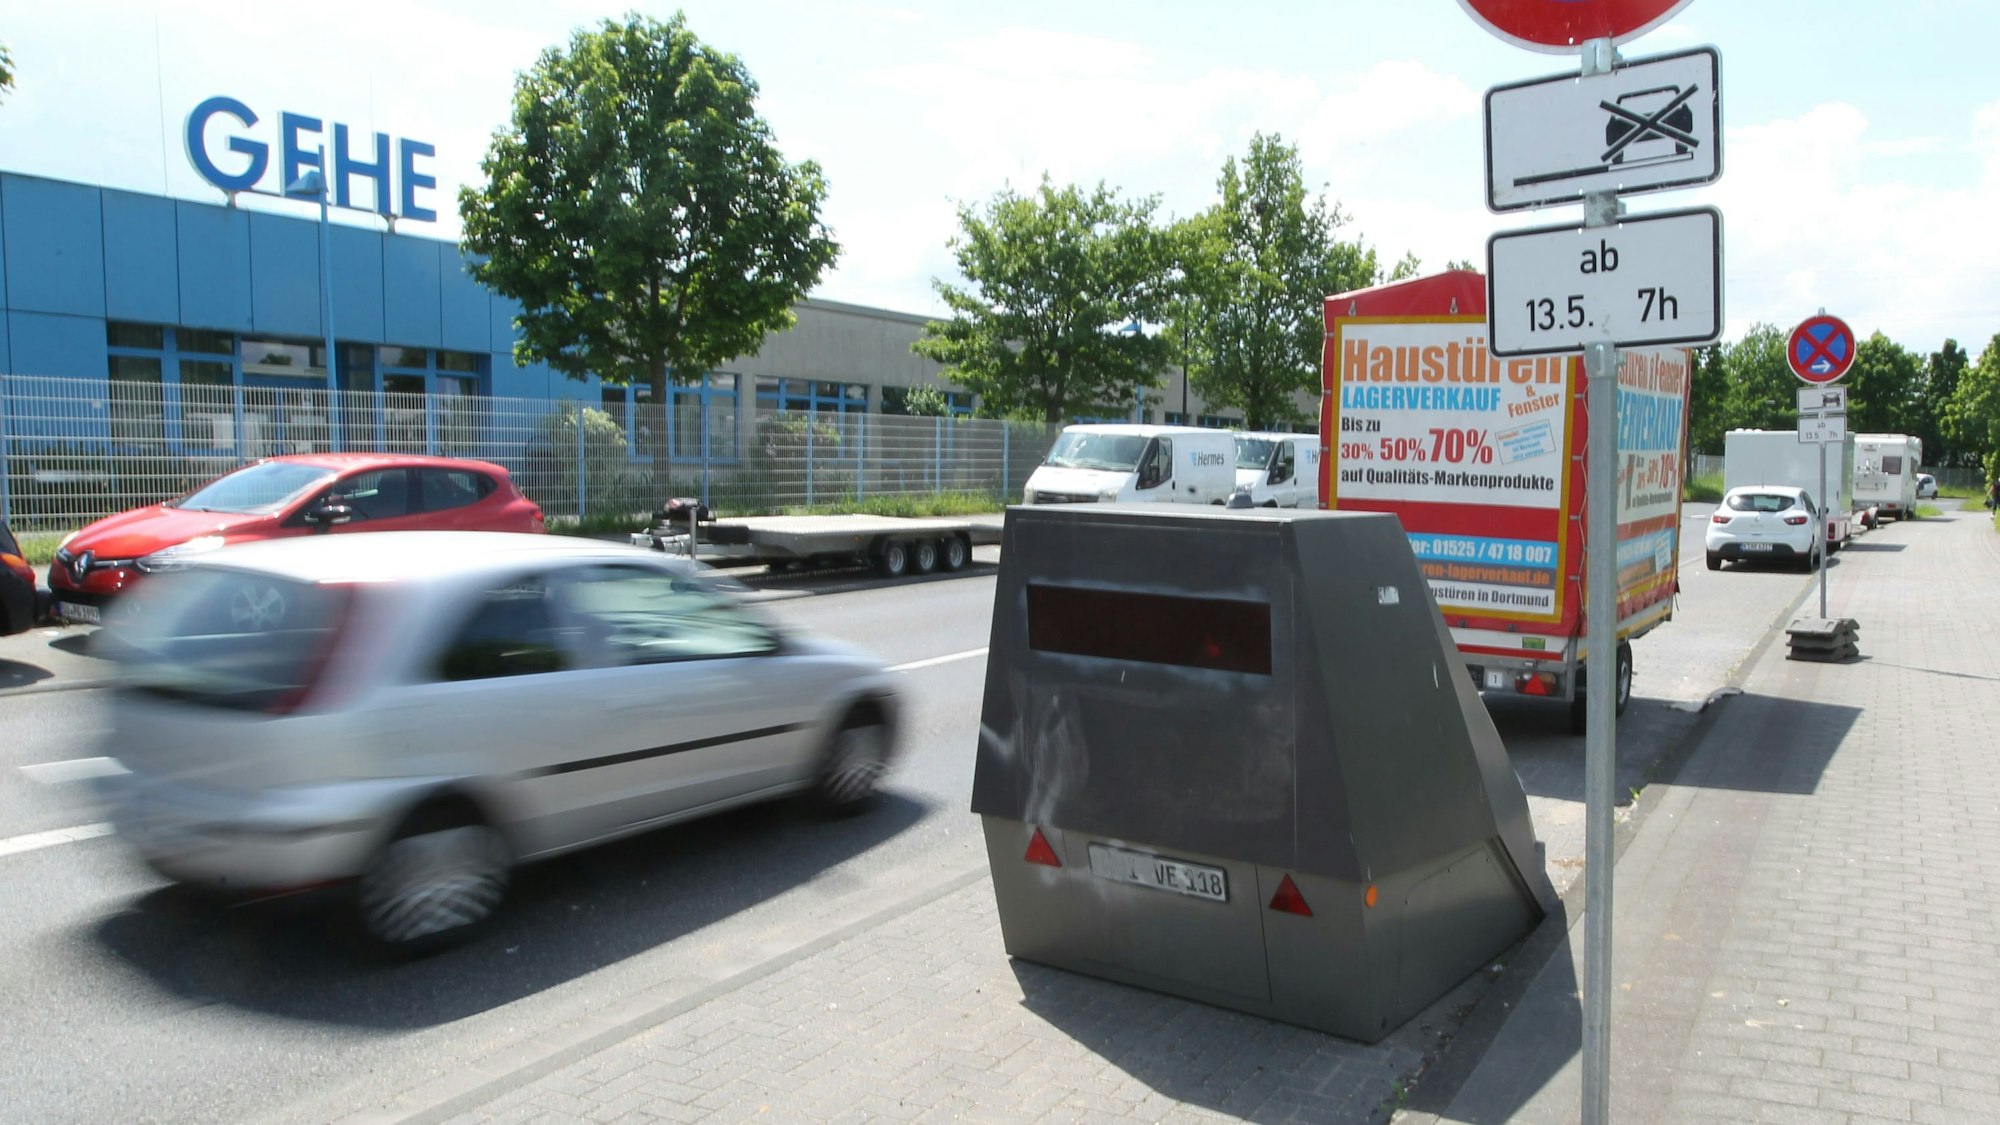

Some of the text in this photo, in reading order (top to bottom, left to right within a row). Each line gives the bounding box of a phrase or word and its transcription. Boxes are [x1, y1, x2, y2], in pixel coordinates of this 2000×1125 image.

[183, 95, 437, 222] GEHE
[1580, 239, 1619, 274] ab
[1526, 287, 1678, 332] 13.5. 7h
[1342, 386, 1501, 412] LAGERVERKAUF
[1525, 384, 1536, 398] &
[1507, 393, 1560, 418] Fenster
[1341, 417, 1381, 432] Bis zu
[1817, 421, 1826, 429] ab
[1828, 430, 1838, 439] 7h
[1341, 443, 1374, 460] 30%
[1380, 438, 1426, 462] 50%
[1429, 428, 1493, 464] 70%
[1198, 451, 1225, 467] Hermes
[1341, 468, 1554, 491] auf Qualitäts-Markenprodukte
[1433, 538, 1475, 557] 01525
[1478, 541, 1486, 560] /
[1488, 543, 1504, 559] 47
[1507, 543, 1522, 562] 18
[1525, 546, 1552, 563] 007
[1478, 589, 1489, 603] in
[1491, 590, 1549, 607] Dortmund
